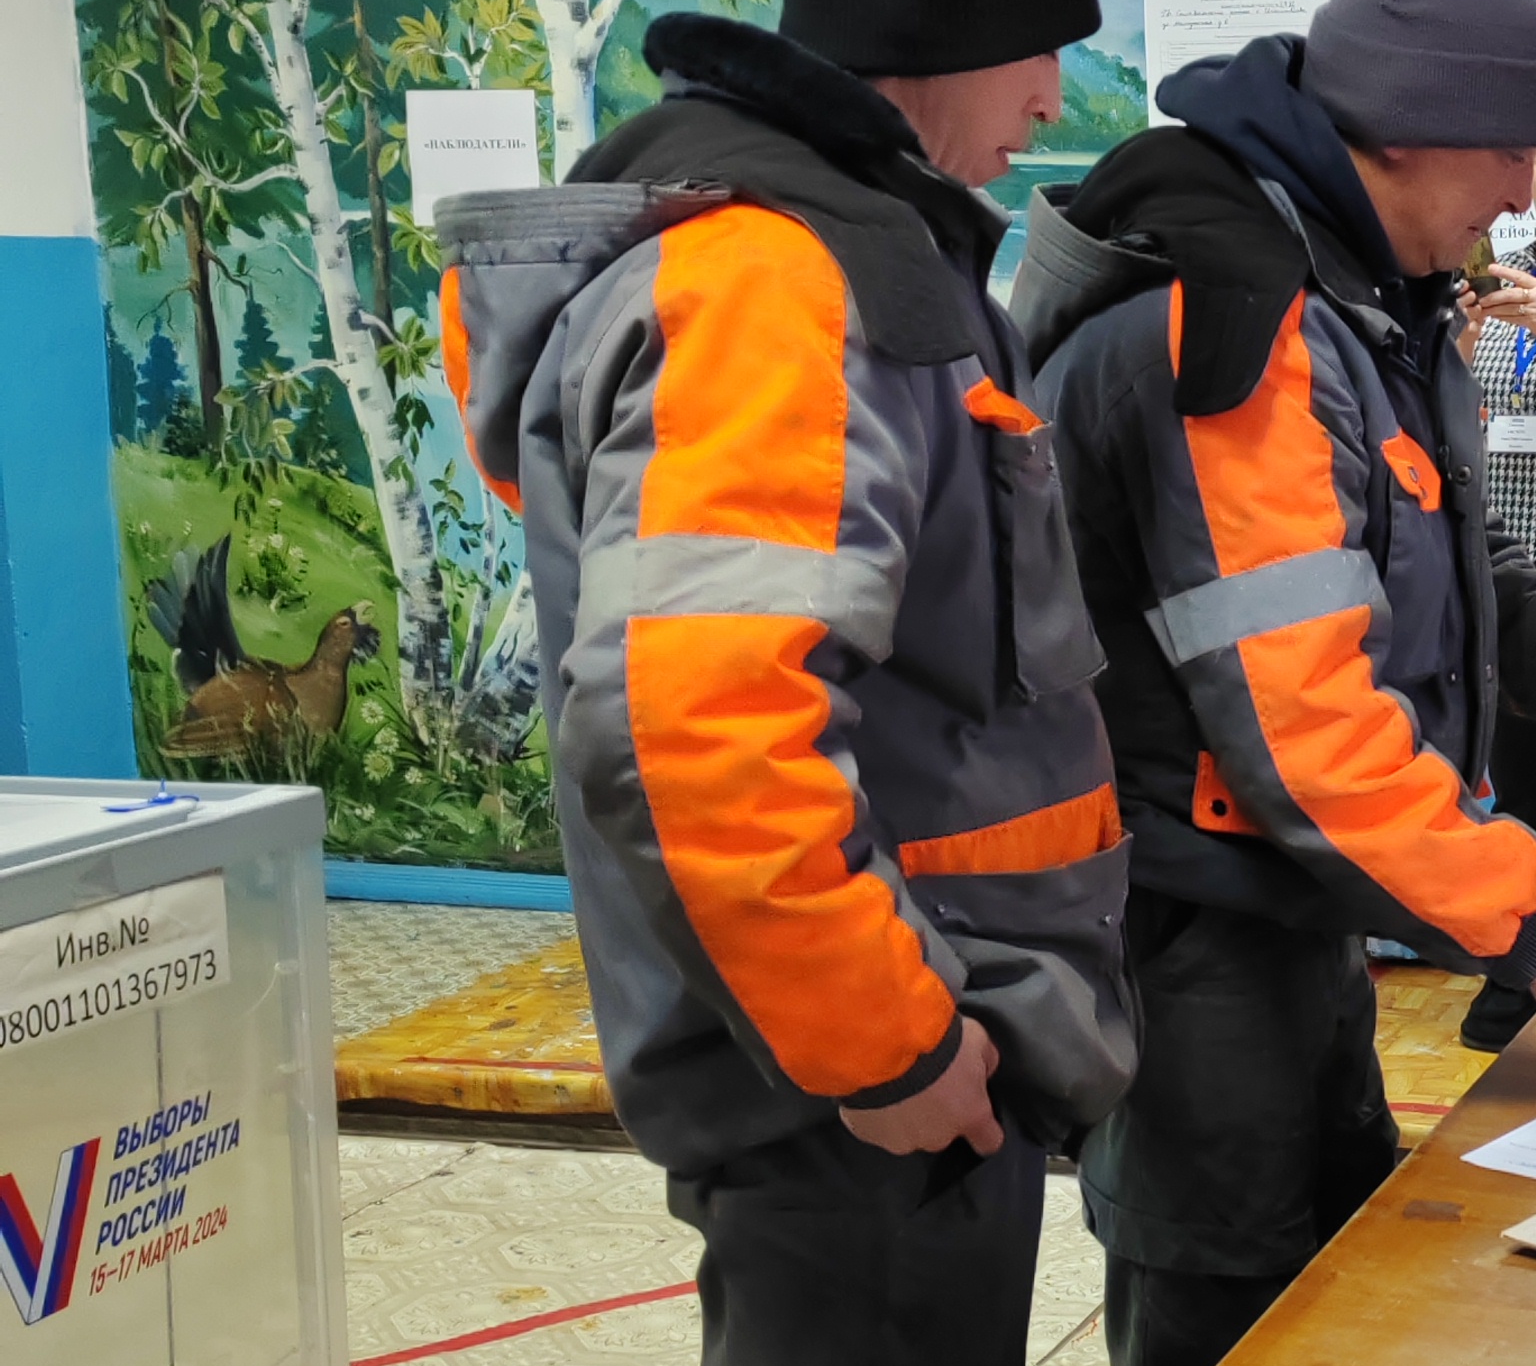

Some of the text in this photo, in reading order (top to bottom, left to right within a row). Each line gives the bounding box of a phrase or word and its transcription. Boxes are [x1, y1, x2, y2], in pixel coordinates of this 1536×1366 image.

[424, 138, 527, 151] «НАБЛЮДАТЕЛИ»
[56, 915, 150, 968] Инв.№
[113, 1090, 211, 1161] ВЫБОРЫ
[104, 1118, 240, 1208] ПРЕЗИДЕНТА
[95, 1184, 187, 1256] РОССИИ
[137, 1223, 189, 1275] МАРТА
[192, 1204, 228, 1245] 2024
